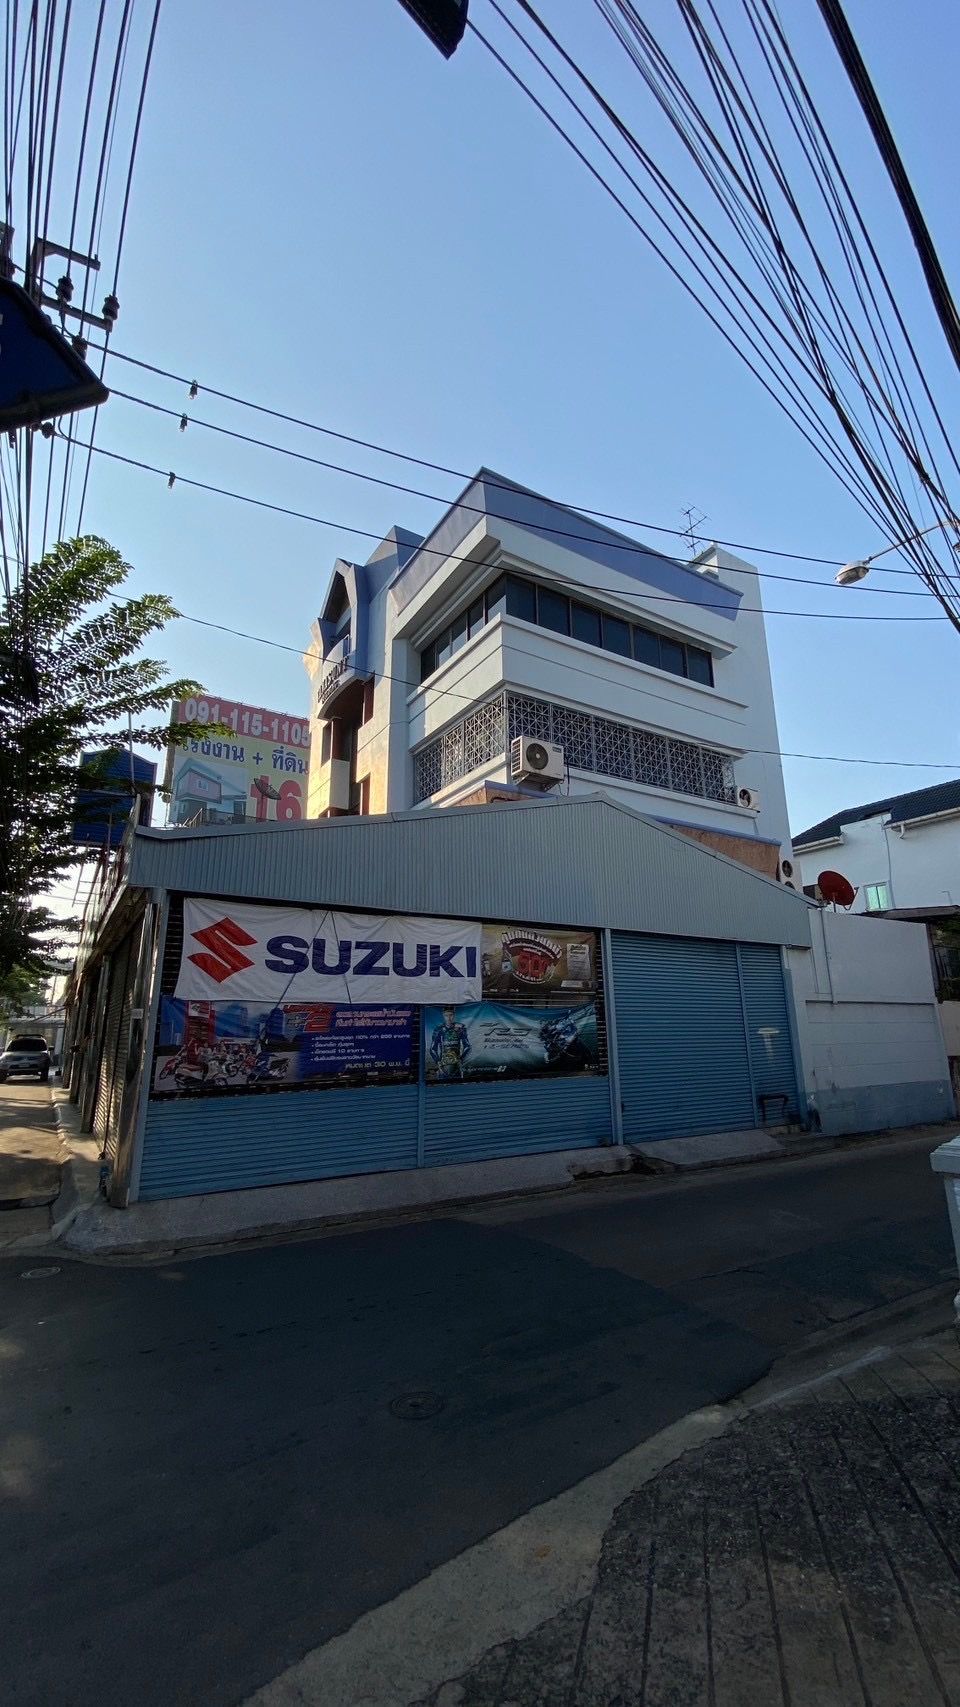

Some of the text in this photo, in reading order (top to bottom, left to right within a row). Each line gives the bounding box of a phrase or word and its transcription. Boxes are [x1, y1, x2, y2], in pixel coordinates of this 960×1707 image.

[253, 752, 263, 765] +
[271, 746, 310, 775] ที่ดิน
[250, 775, 302, 822] 16
[264, 935, 477, 978] SUZUKI
